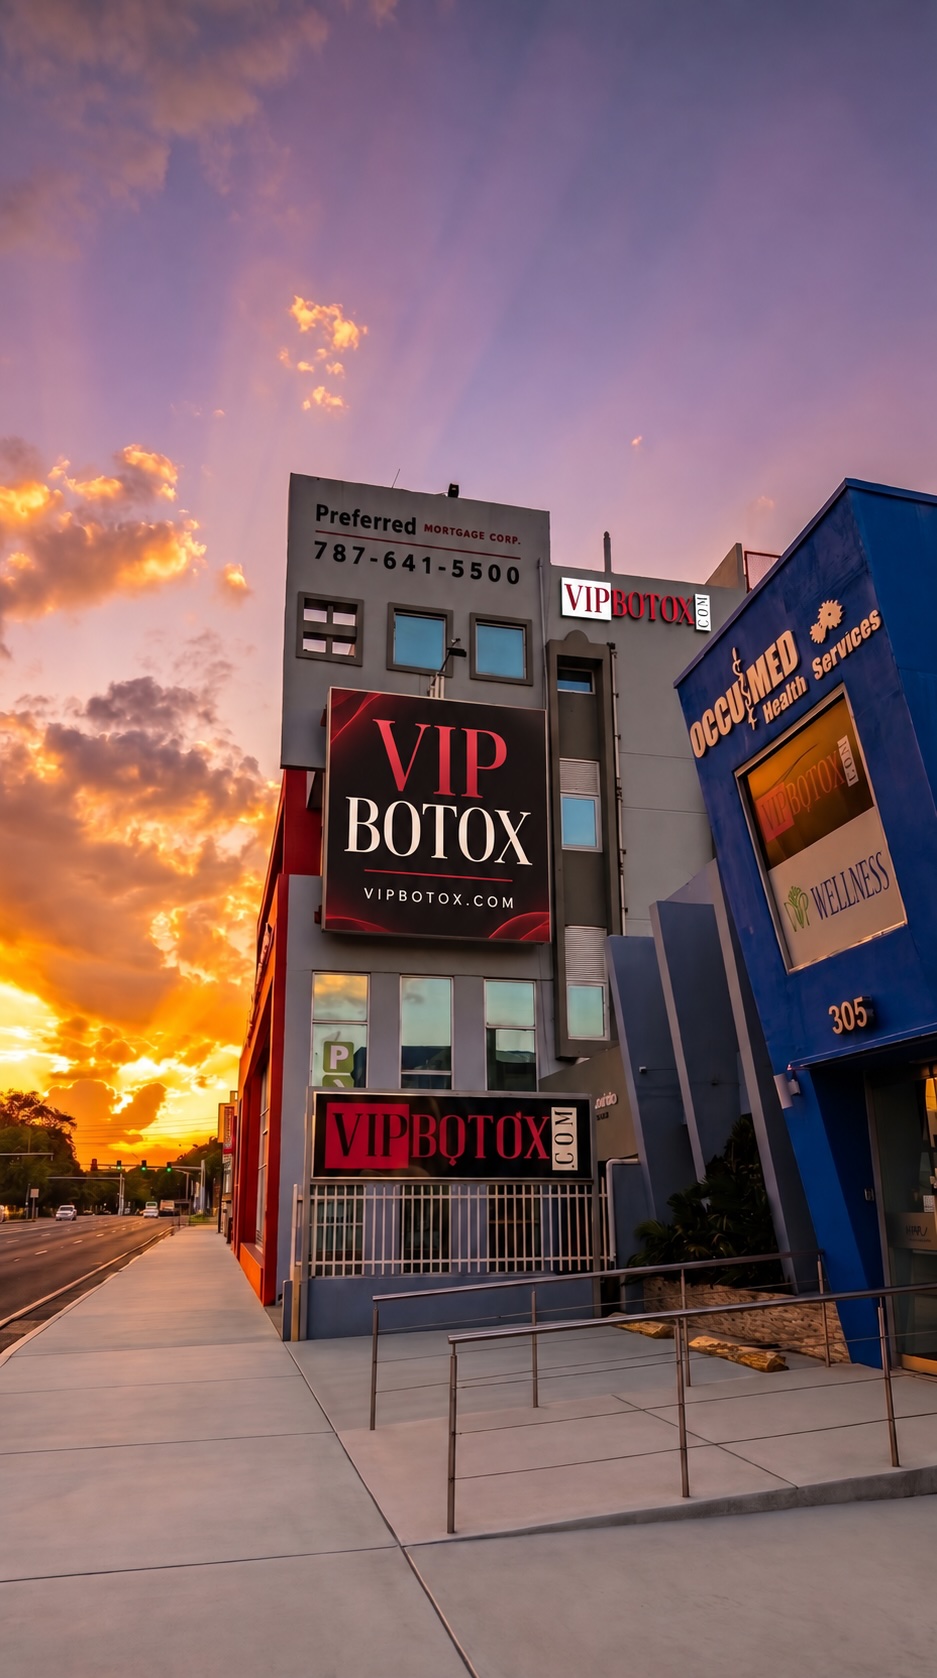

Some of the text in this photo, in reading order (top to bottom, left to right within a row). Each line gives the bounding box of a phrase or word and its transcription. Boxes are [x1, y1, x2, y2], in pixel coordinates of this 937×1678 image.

[315, 503, 521, 545] Preferred MORTGAGE CORP.
[314, 540, 520, 584] 787-641-5500
[762, 609, 882, 725] Health Services
[373, 718, 508, 799] VIP
[344, 796, 533, 866] BOTOX
[363, 887, 514, 909] VIPBOTOX.COM
[810, 851, 890, 920] WELLNESS
[828, 996, 868, 1036] 305
[330, 1044, 349, 1070] P
